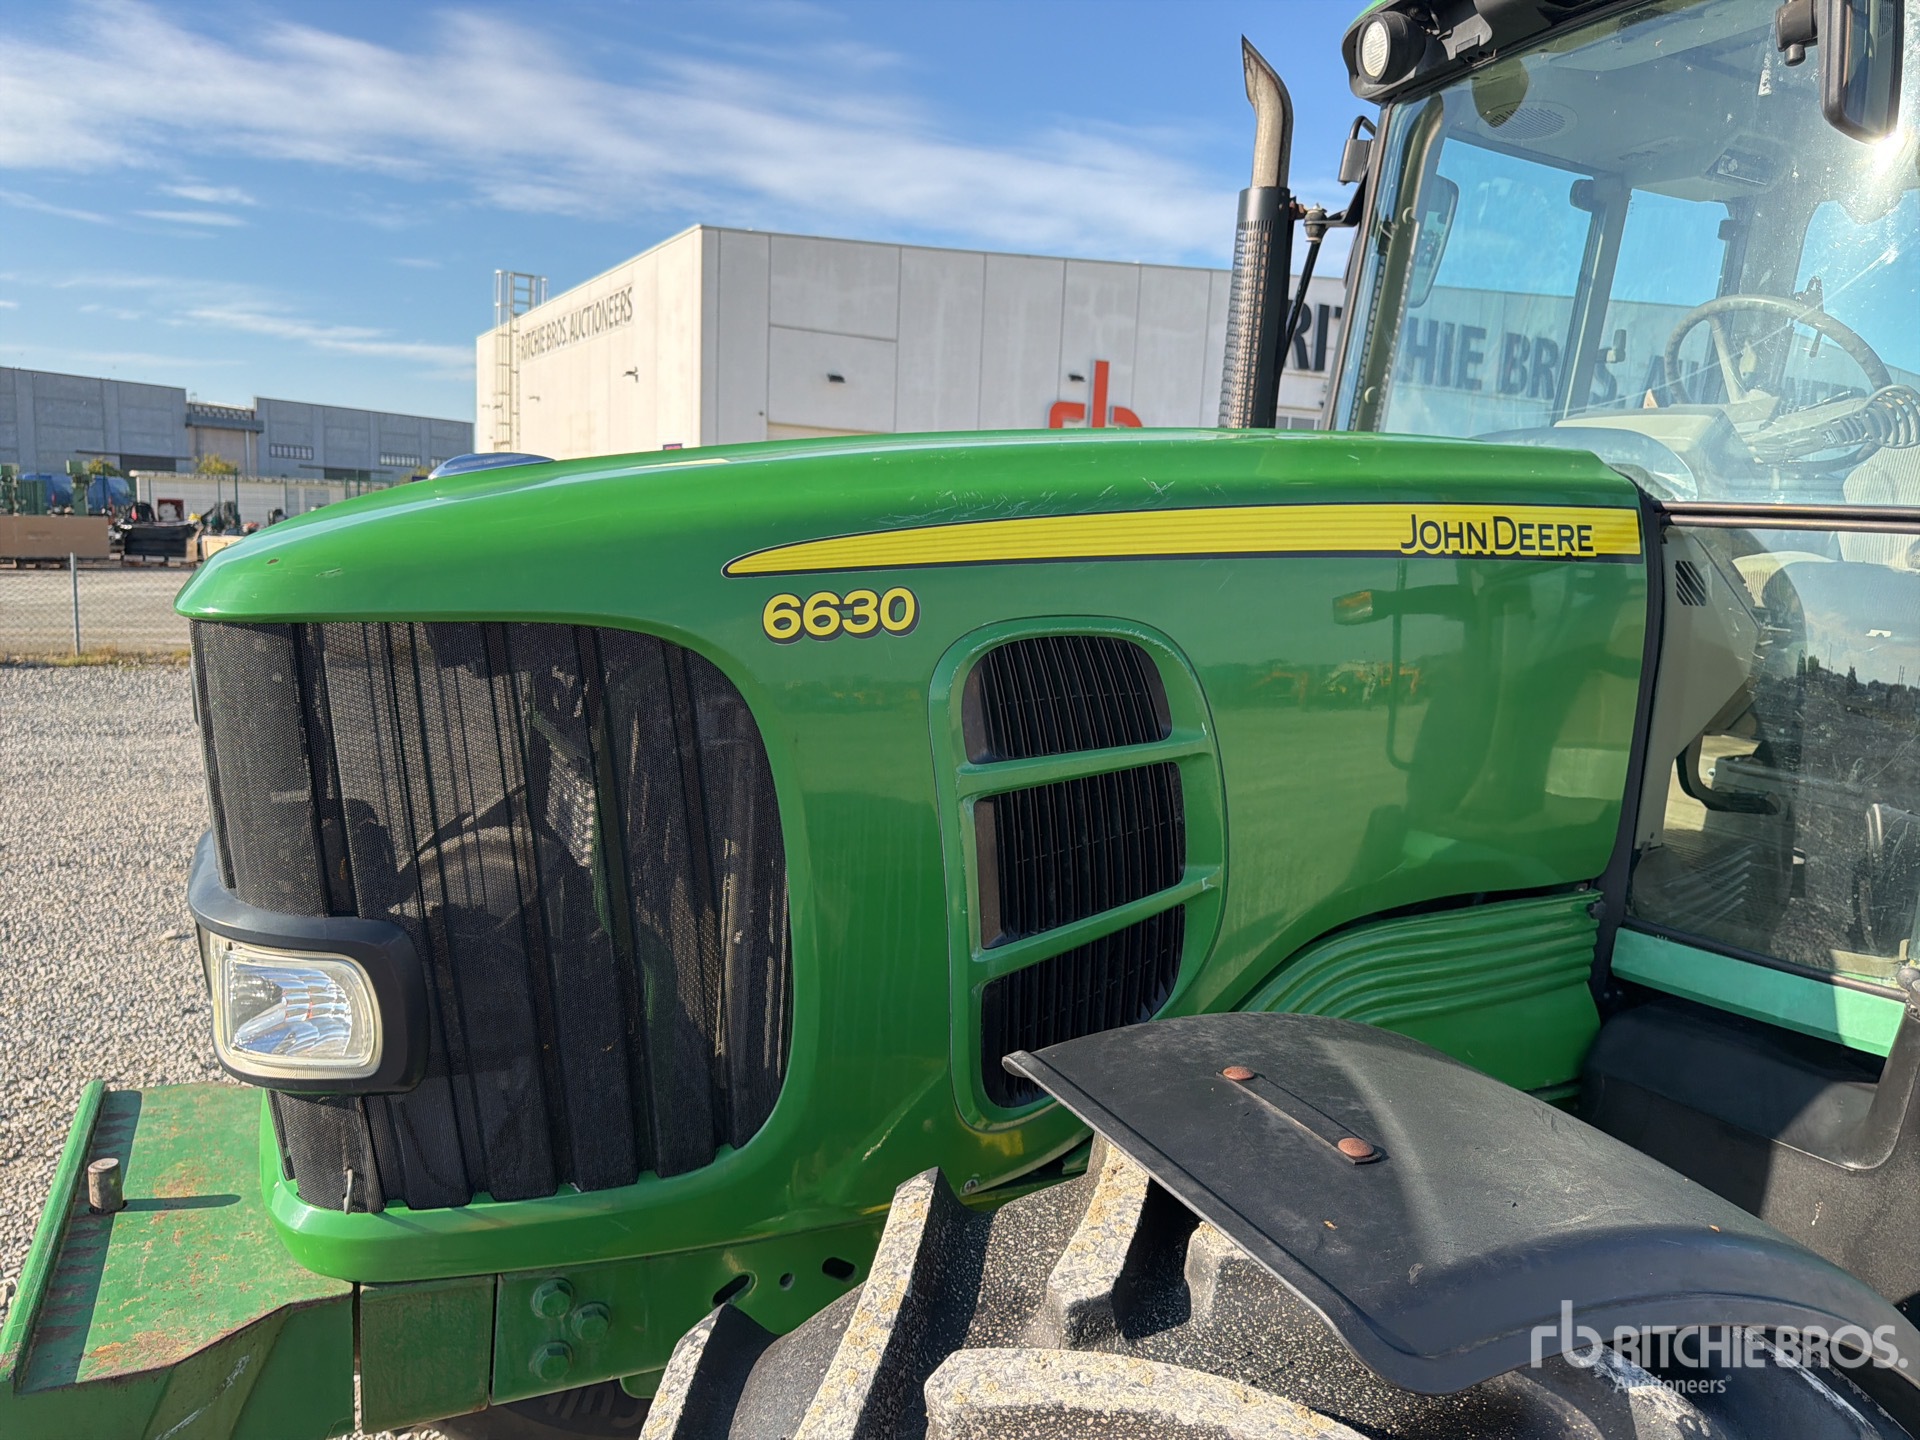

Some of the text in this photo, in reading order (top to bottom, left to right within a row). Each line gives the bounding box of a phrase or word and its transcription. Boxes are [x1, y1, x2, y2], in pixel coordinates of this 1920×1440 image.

[520, 327, 545, 360] RITCHIE
[569, 286, 633, 343] AUCTIONEERS
[1400, 513, 1597, 555] JOHN DEERE
[762, 586, 920, 643] 6630
